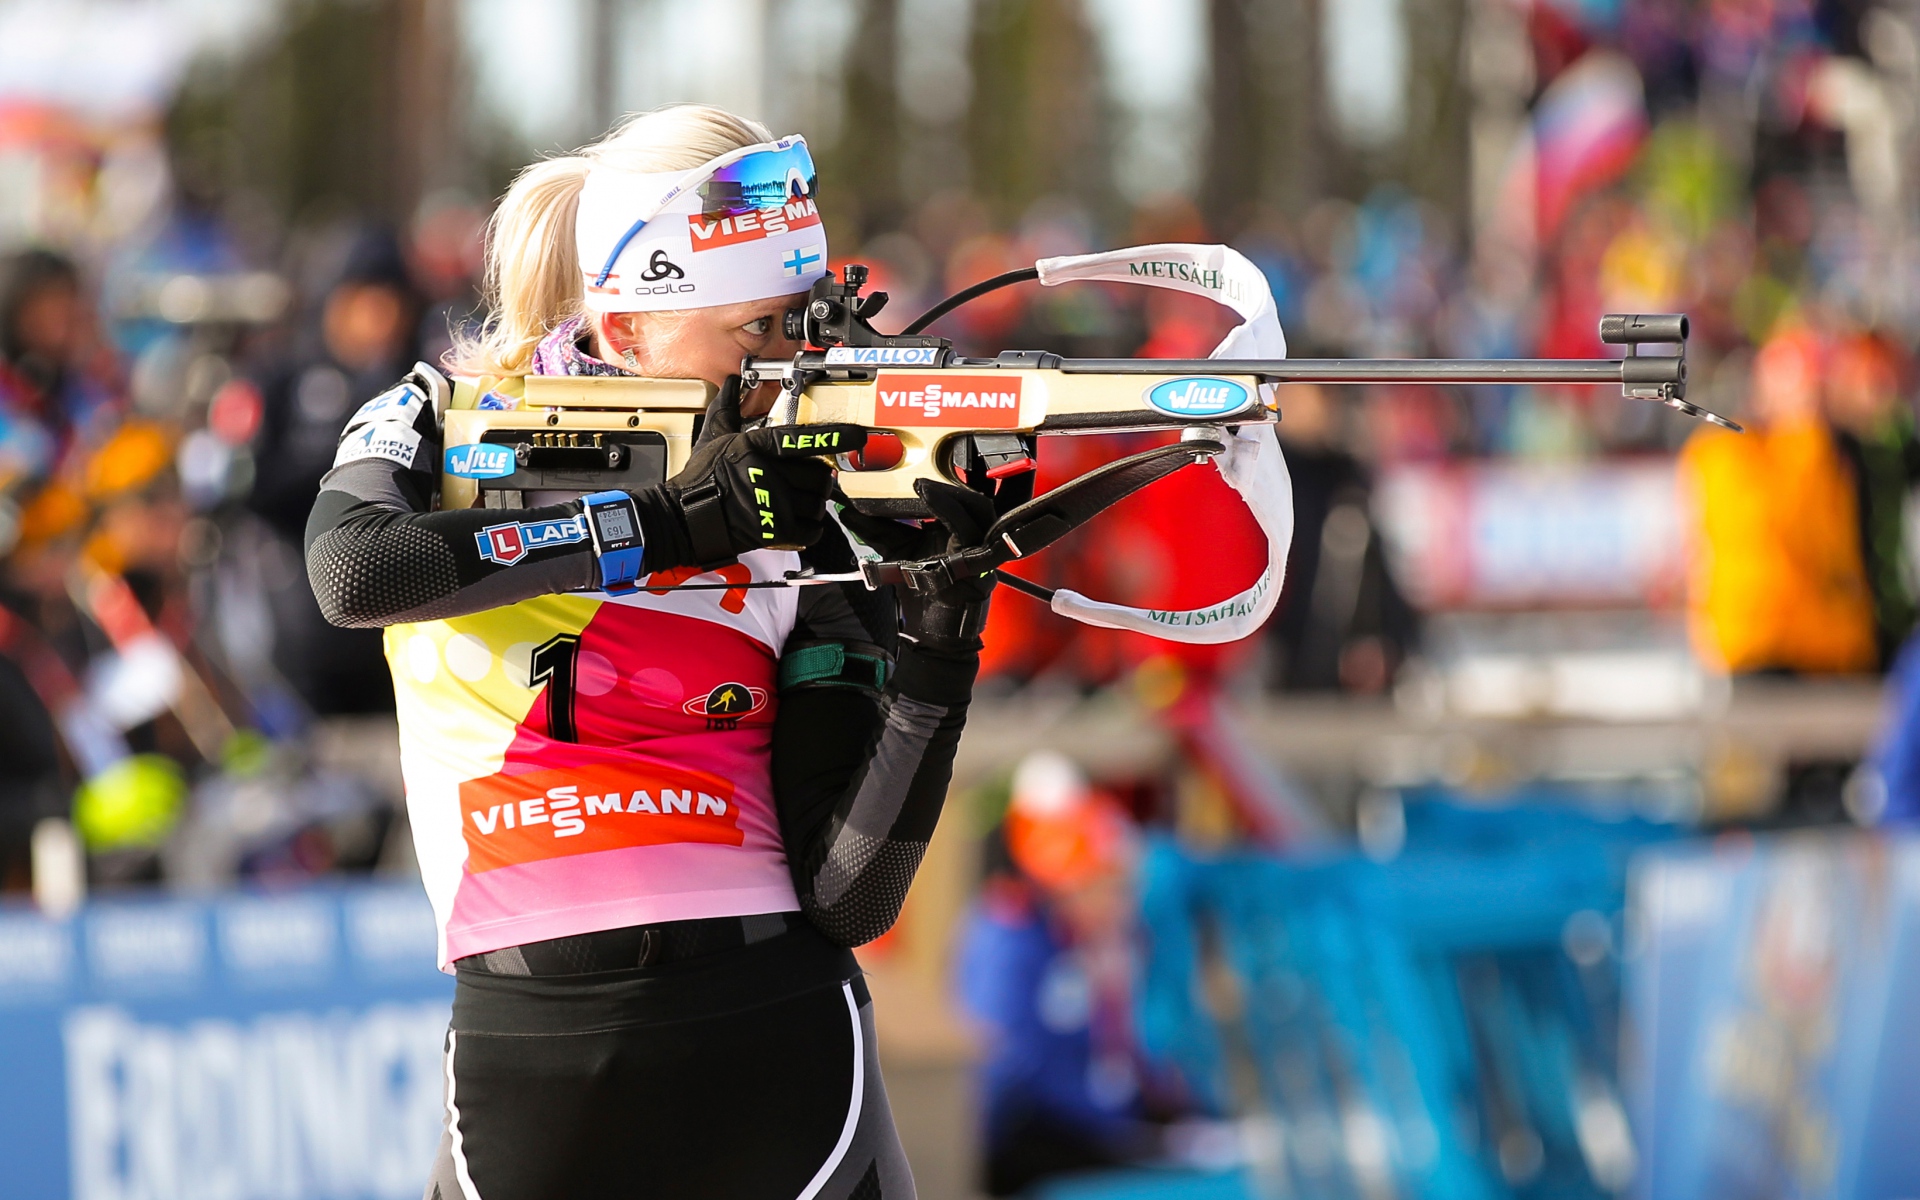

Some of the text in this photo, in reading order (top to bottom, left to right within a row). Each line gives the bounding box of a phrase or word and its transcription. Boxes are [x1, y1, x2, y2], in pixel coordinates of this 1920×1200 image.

[635, 282, 695, 295] odlo
[853, 349, 936, 363] VALLOX
[879, 384, 1016, 417] VIESSMANN
[781, 432, 840, 449] LEKI
[747, 466, 775, 539] LEKI
[607, 525, 624, 537] 163
[529, 632, 581, 744] 1
[471, 785, 728, 838] VIESSMANN
